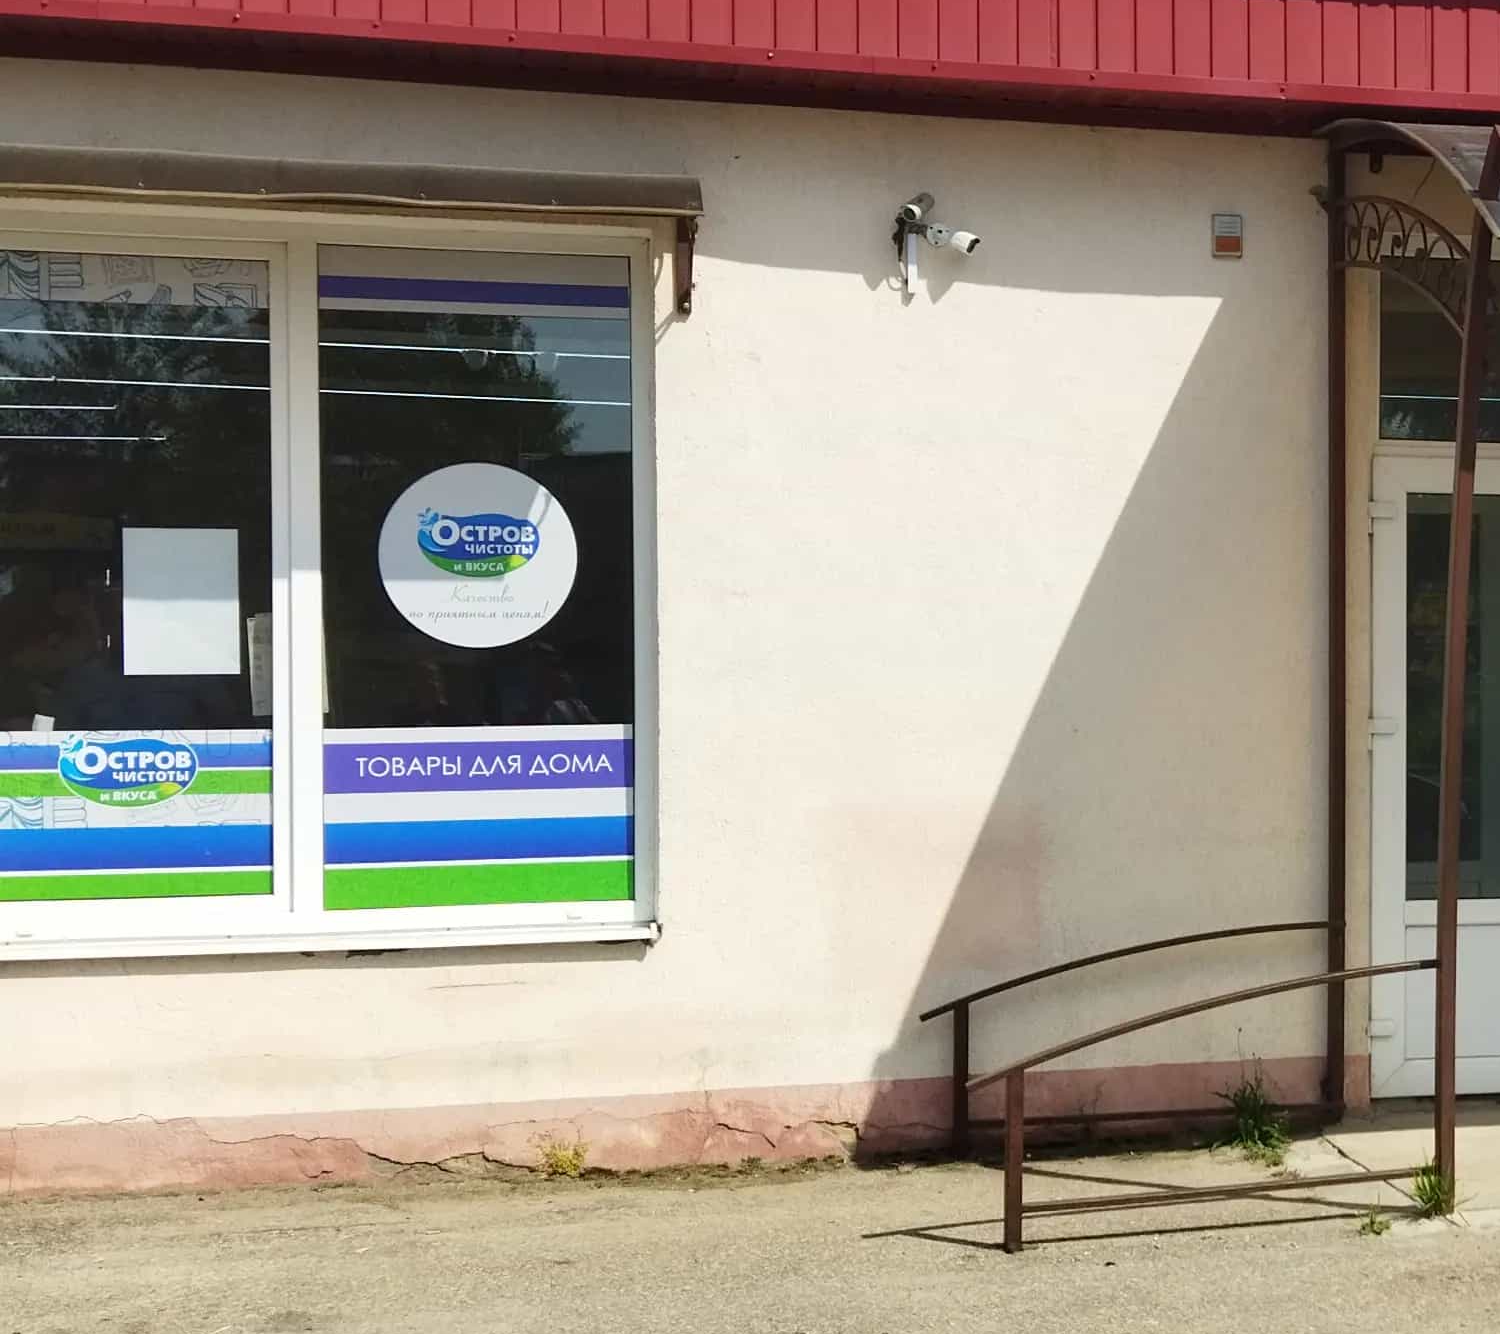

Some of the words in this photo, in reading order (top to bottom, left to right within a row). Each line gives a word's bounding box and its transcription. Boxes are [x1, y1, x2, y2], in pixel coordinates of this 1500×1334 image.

[431, 519, 535, 546] ОСТРОВ
[465, 544, 533, 555] ЧИСТОТЫ
[465, 562, 505, 572] ВКУСА
[75, 746, 192, 775] ОСТРОВ
[355, 755, 461, 778] ТОВАРЫ
[469, 754, 521, 778] ДЛЯ
[529, 753, 613, 776] ДОМА
[112, 770, 190, 783] ЧИСТОТЫ
[112, 790, 158, 801] ВКУСА
